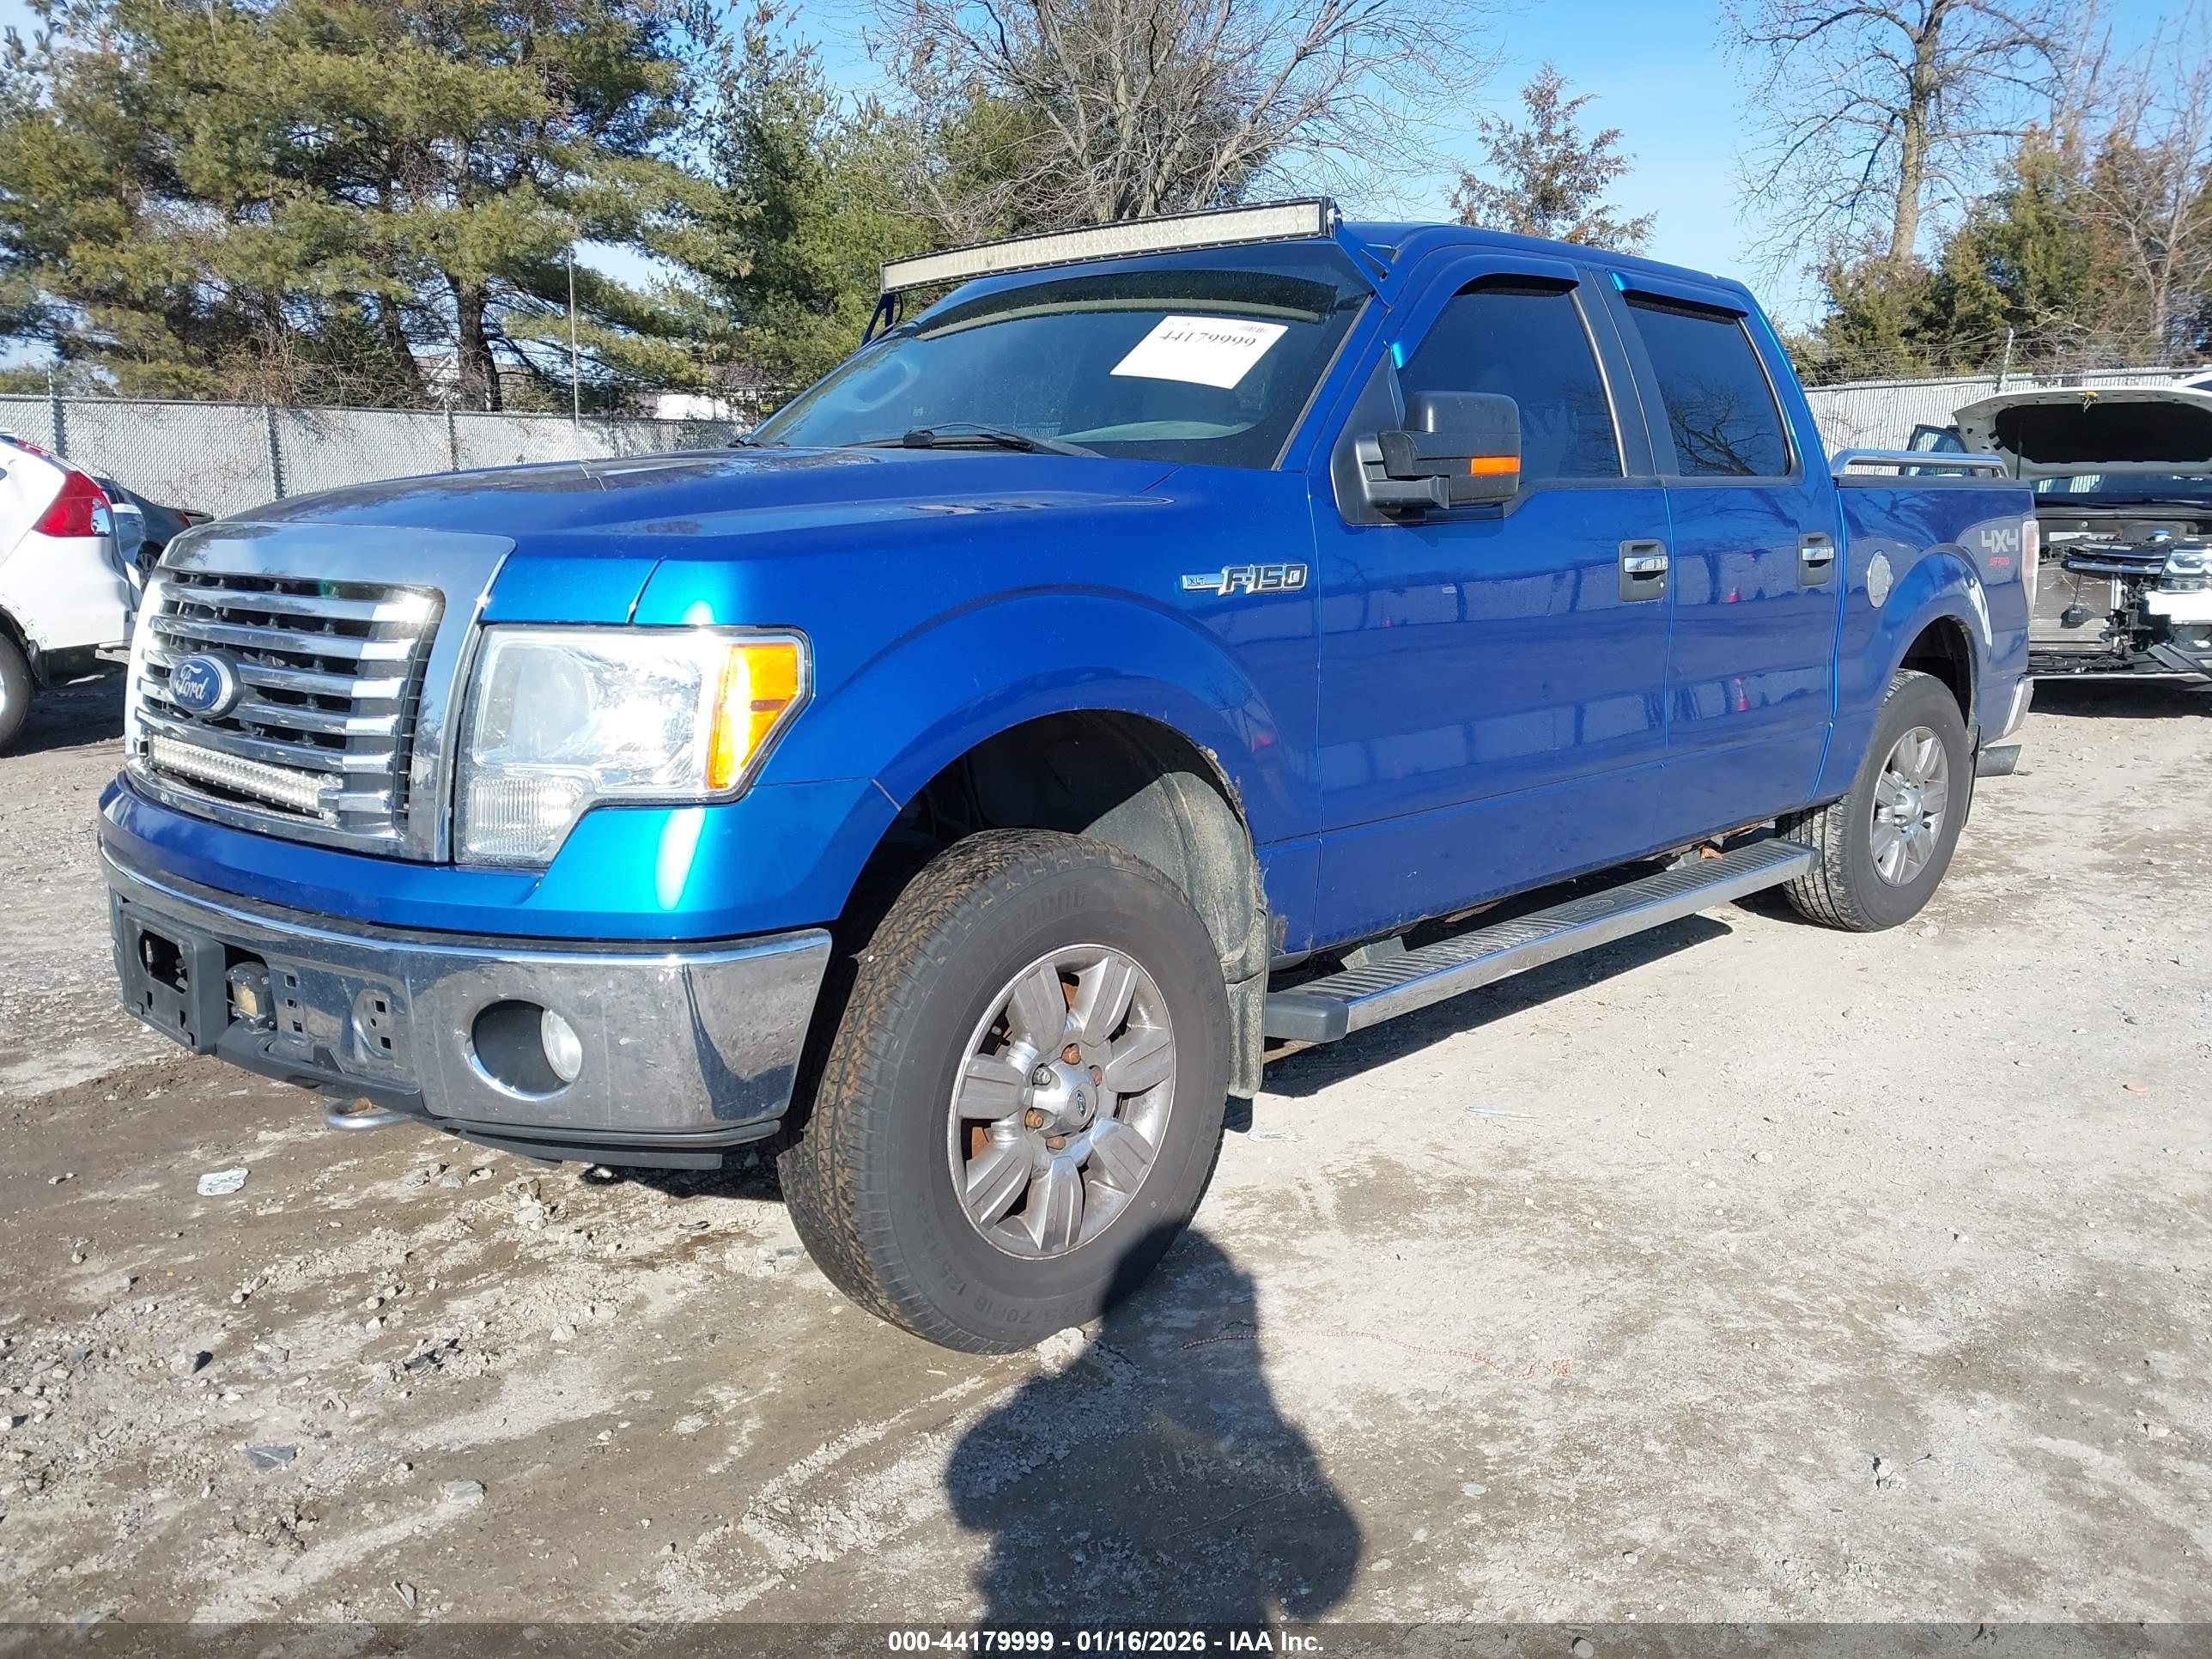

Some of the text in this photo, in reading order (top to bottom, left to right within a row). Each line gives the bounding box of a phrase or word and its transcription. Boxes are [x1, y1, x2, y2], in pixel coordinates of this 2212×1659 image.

[1159, 331, 1256, 347] 44179999
[1188, 563, 1308, 596] XLT F-150
[175, 664, 210, 701] Ford
